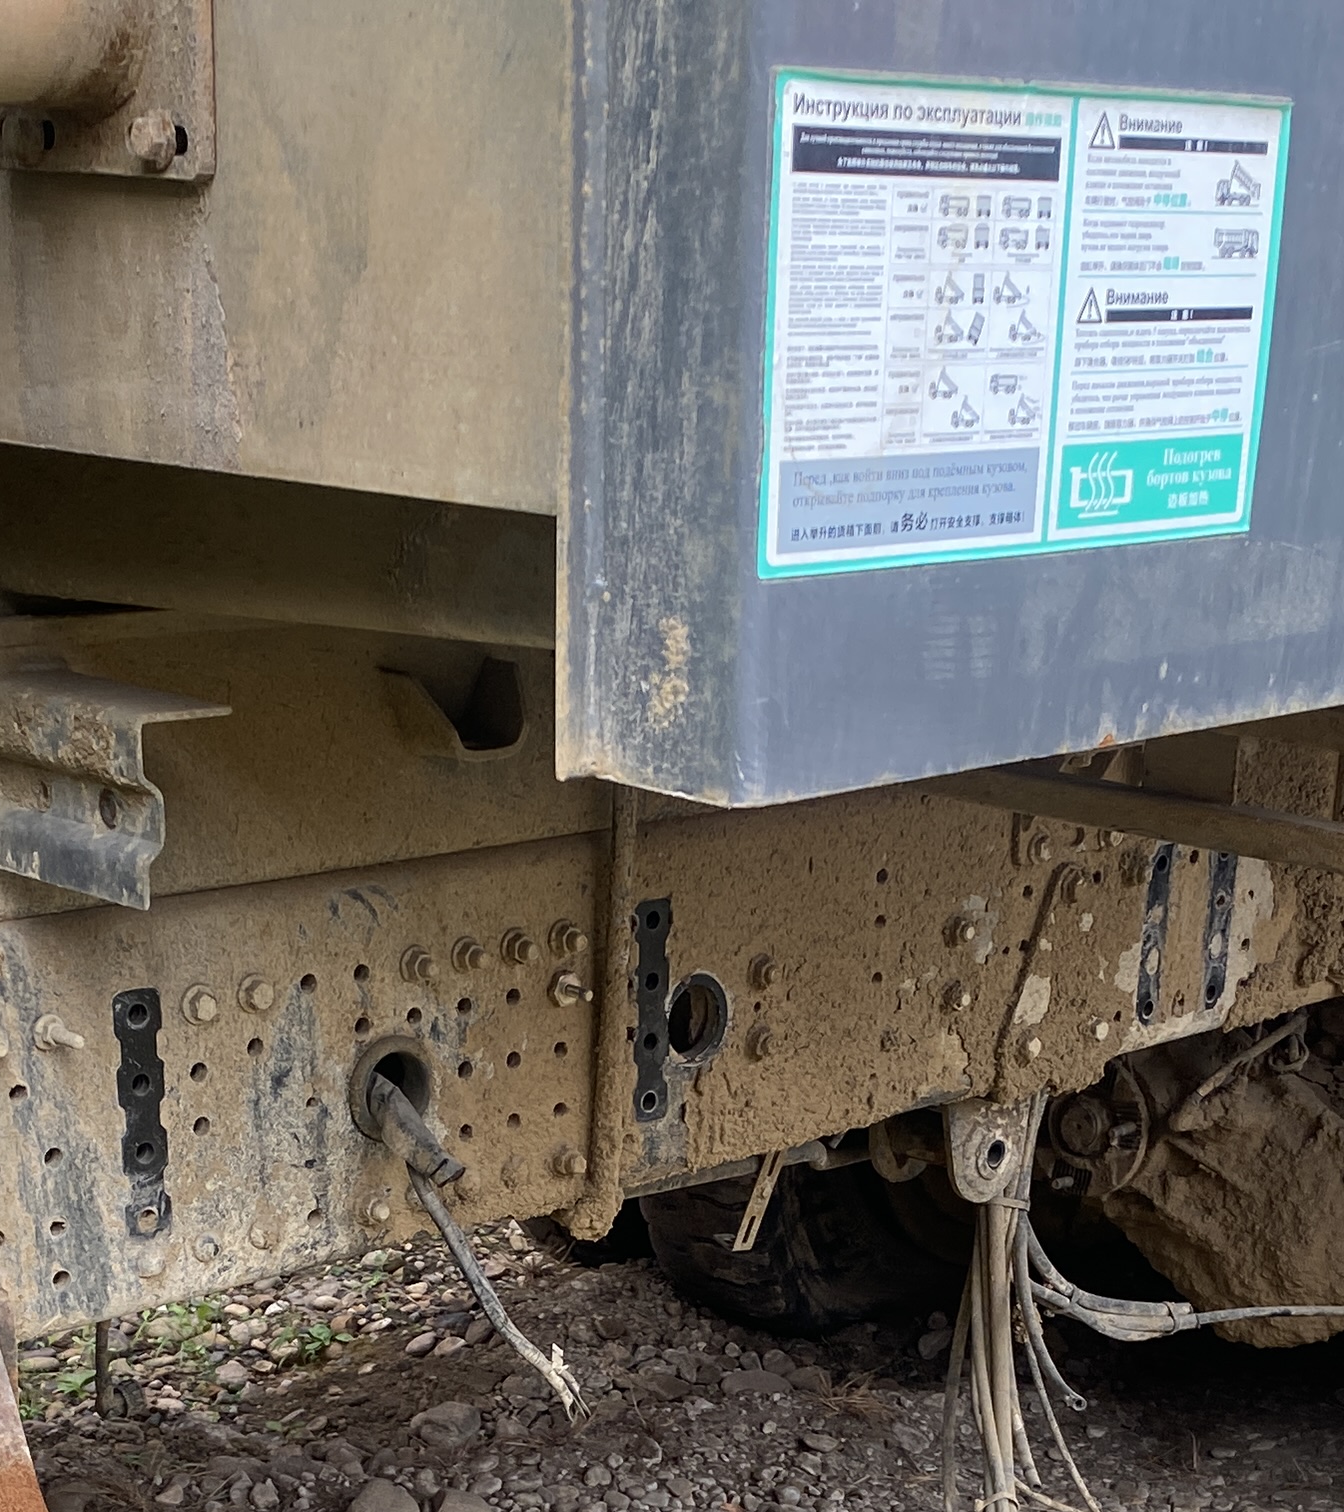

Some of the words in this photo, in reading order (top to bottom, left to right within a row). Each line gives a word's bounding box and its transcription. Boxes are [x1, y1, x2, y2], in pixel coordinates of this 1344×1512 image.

[793, 92, 889, 122] Инструкция
[892, 103, 913, 120] по
[918, 104, 1022, 129] эксплуатации
[1119, 113, 1184, 134] Внимание
[1106, 288, 1169, 305] Внимание
[1163, 447, 1222, 467] Подогрев
[793, 471, 827, 488] Перед
[852, 468, 883, 484] войти
[886, 468, 909, 481] вниз
[912, 466, 931, 480] под
[1146, 468, 1189, 490] бортов
[1192, 467, 1232, 486] кузова
[856, 487, 905, 505] подпорку
[907, 486, 926, 500] для
